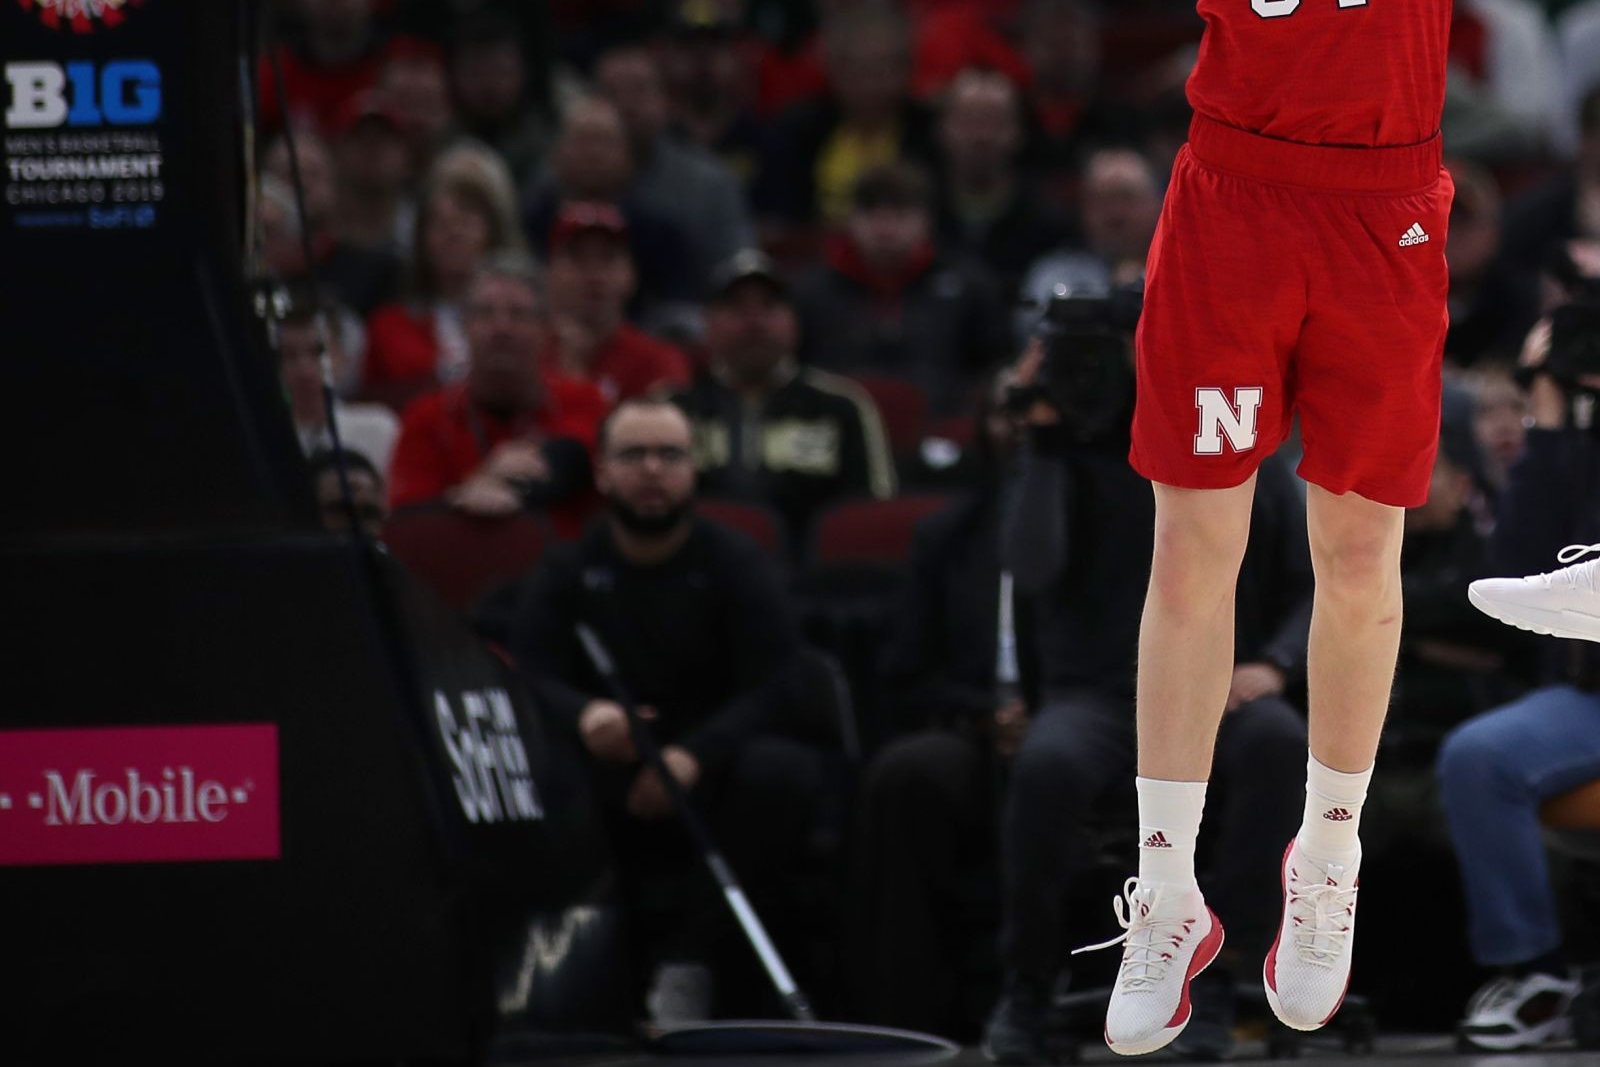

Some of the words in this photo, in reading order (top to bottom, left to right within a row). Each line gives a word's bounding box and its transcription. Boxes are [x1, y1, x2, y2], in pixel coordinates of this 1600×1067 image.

[6, 154, 163, 182] TOURNAMENT
[5, 181, 106, 205] CHICAGO
[1398, 232, 1430, 247] adidas
[1193, 386, 1263, 456] N
[1323, 811, 1354, 822] adidas
[1143, 839, 1173, 849] adidas
